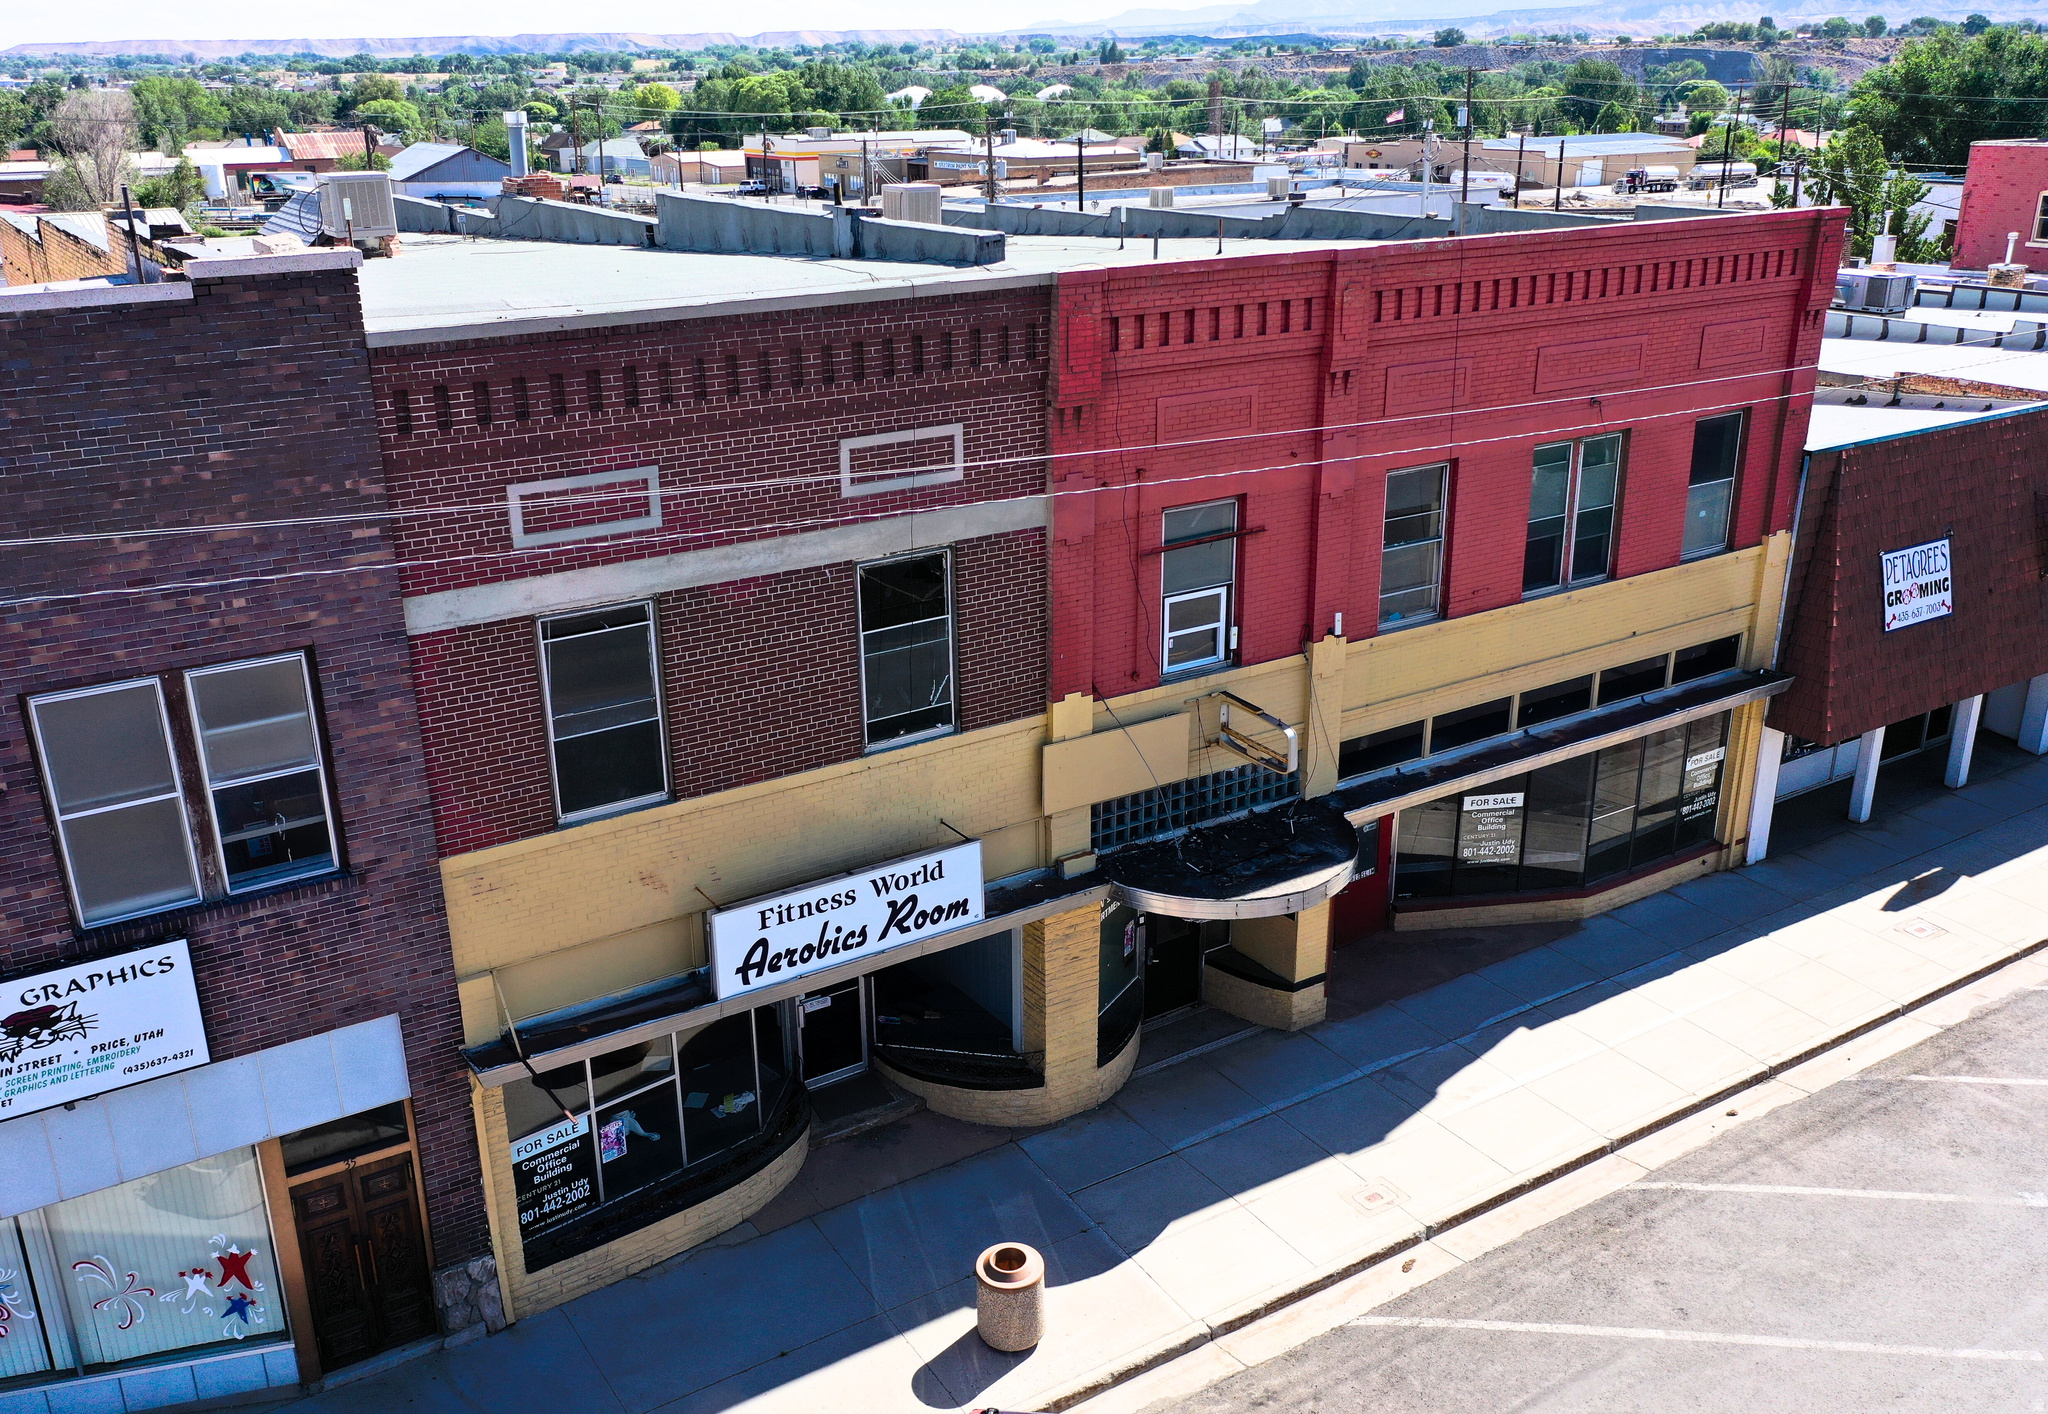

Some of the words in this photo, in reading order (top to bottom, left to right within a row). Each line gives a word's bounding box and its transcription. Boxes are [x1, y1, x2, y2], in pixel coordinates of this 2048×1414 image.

[1885, 543, 1948, 586] PETAGREES
[1886, 577, 1950, 608] GROOMING
[1690, 757, 1703, 767] FOR
[1704, 750, 1721, 762] SALE
[1690, 763, 1719, 777] Commercial
[1693, 778, 1712, 789] Building
[1470, 798, 1490, 807] FOR
[1492, 796, 1517, 806] SALE
[1471, 809, 1515, 818] Commercial
[1463, 845, 1515, 857] 801-442-2002
[757, 888, 857, 931] Fitness
[869, 860, 945, 898] World
[734, 920, 868, 986] Aerobics
[877, 893, 969, 943] Room
[20, 955, 175, 1006] GRAPHICS
[0, 1067, 13, 1078] IN
[16, 1054, 62, 1074] STREET
[90, 1038, 130, 1054] PRICE,
[133, 1028, 164, 1043] UTAH
[5, 1072, 38, 1088] SCREEN
[41, 1060, 84, 1078] PRINTING,
[86, 1045, 141, 1066] EMBROIDERY
[123, 1048, 194, 1075] (435)637-4321
[4, 1079, 48, 1098] GRAPHICS
[50, 1074, 69, 1086] AND
[70, 1062, 115, 1080] LETTERING
[1, 1098, 13, 1108] ET
[516, 1139, 543, 1157] FOR
[547, 1122, 580, 1144] SALE
[521, 1139, 580, 1171] Commercial
[536, 1156, 567, 1173] Office
[533, 1163, 573, 1185] Building
[517, 1183, 553, 1203] CENTURY
[542, 1186, 569, 1203] Justin
[571, 1177, 589, 1189] Udy
[520, 1184, 591, 1225] 801-442-2002
